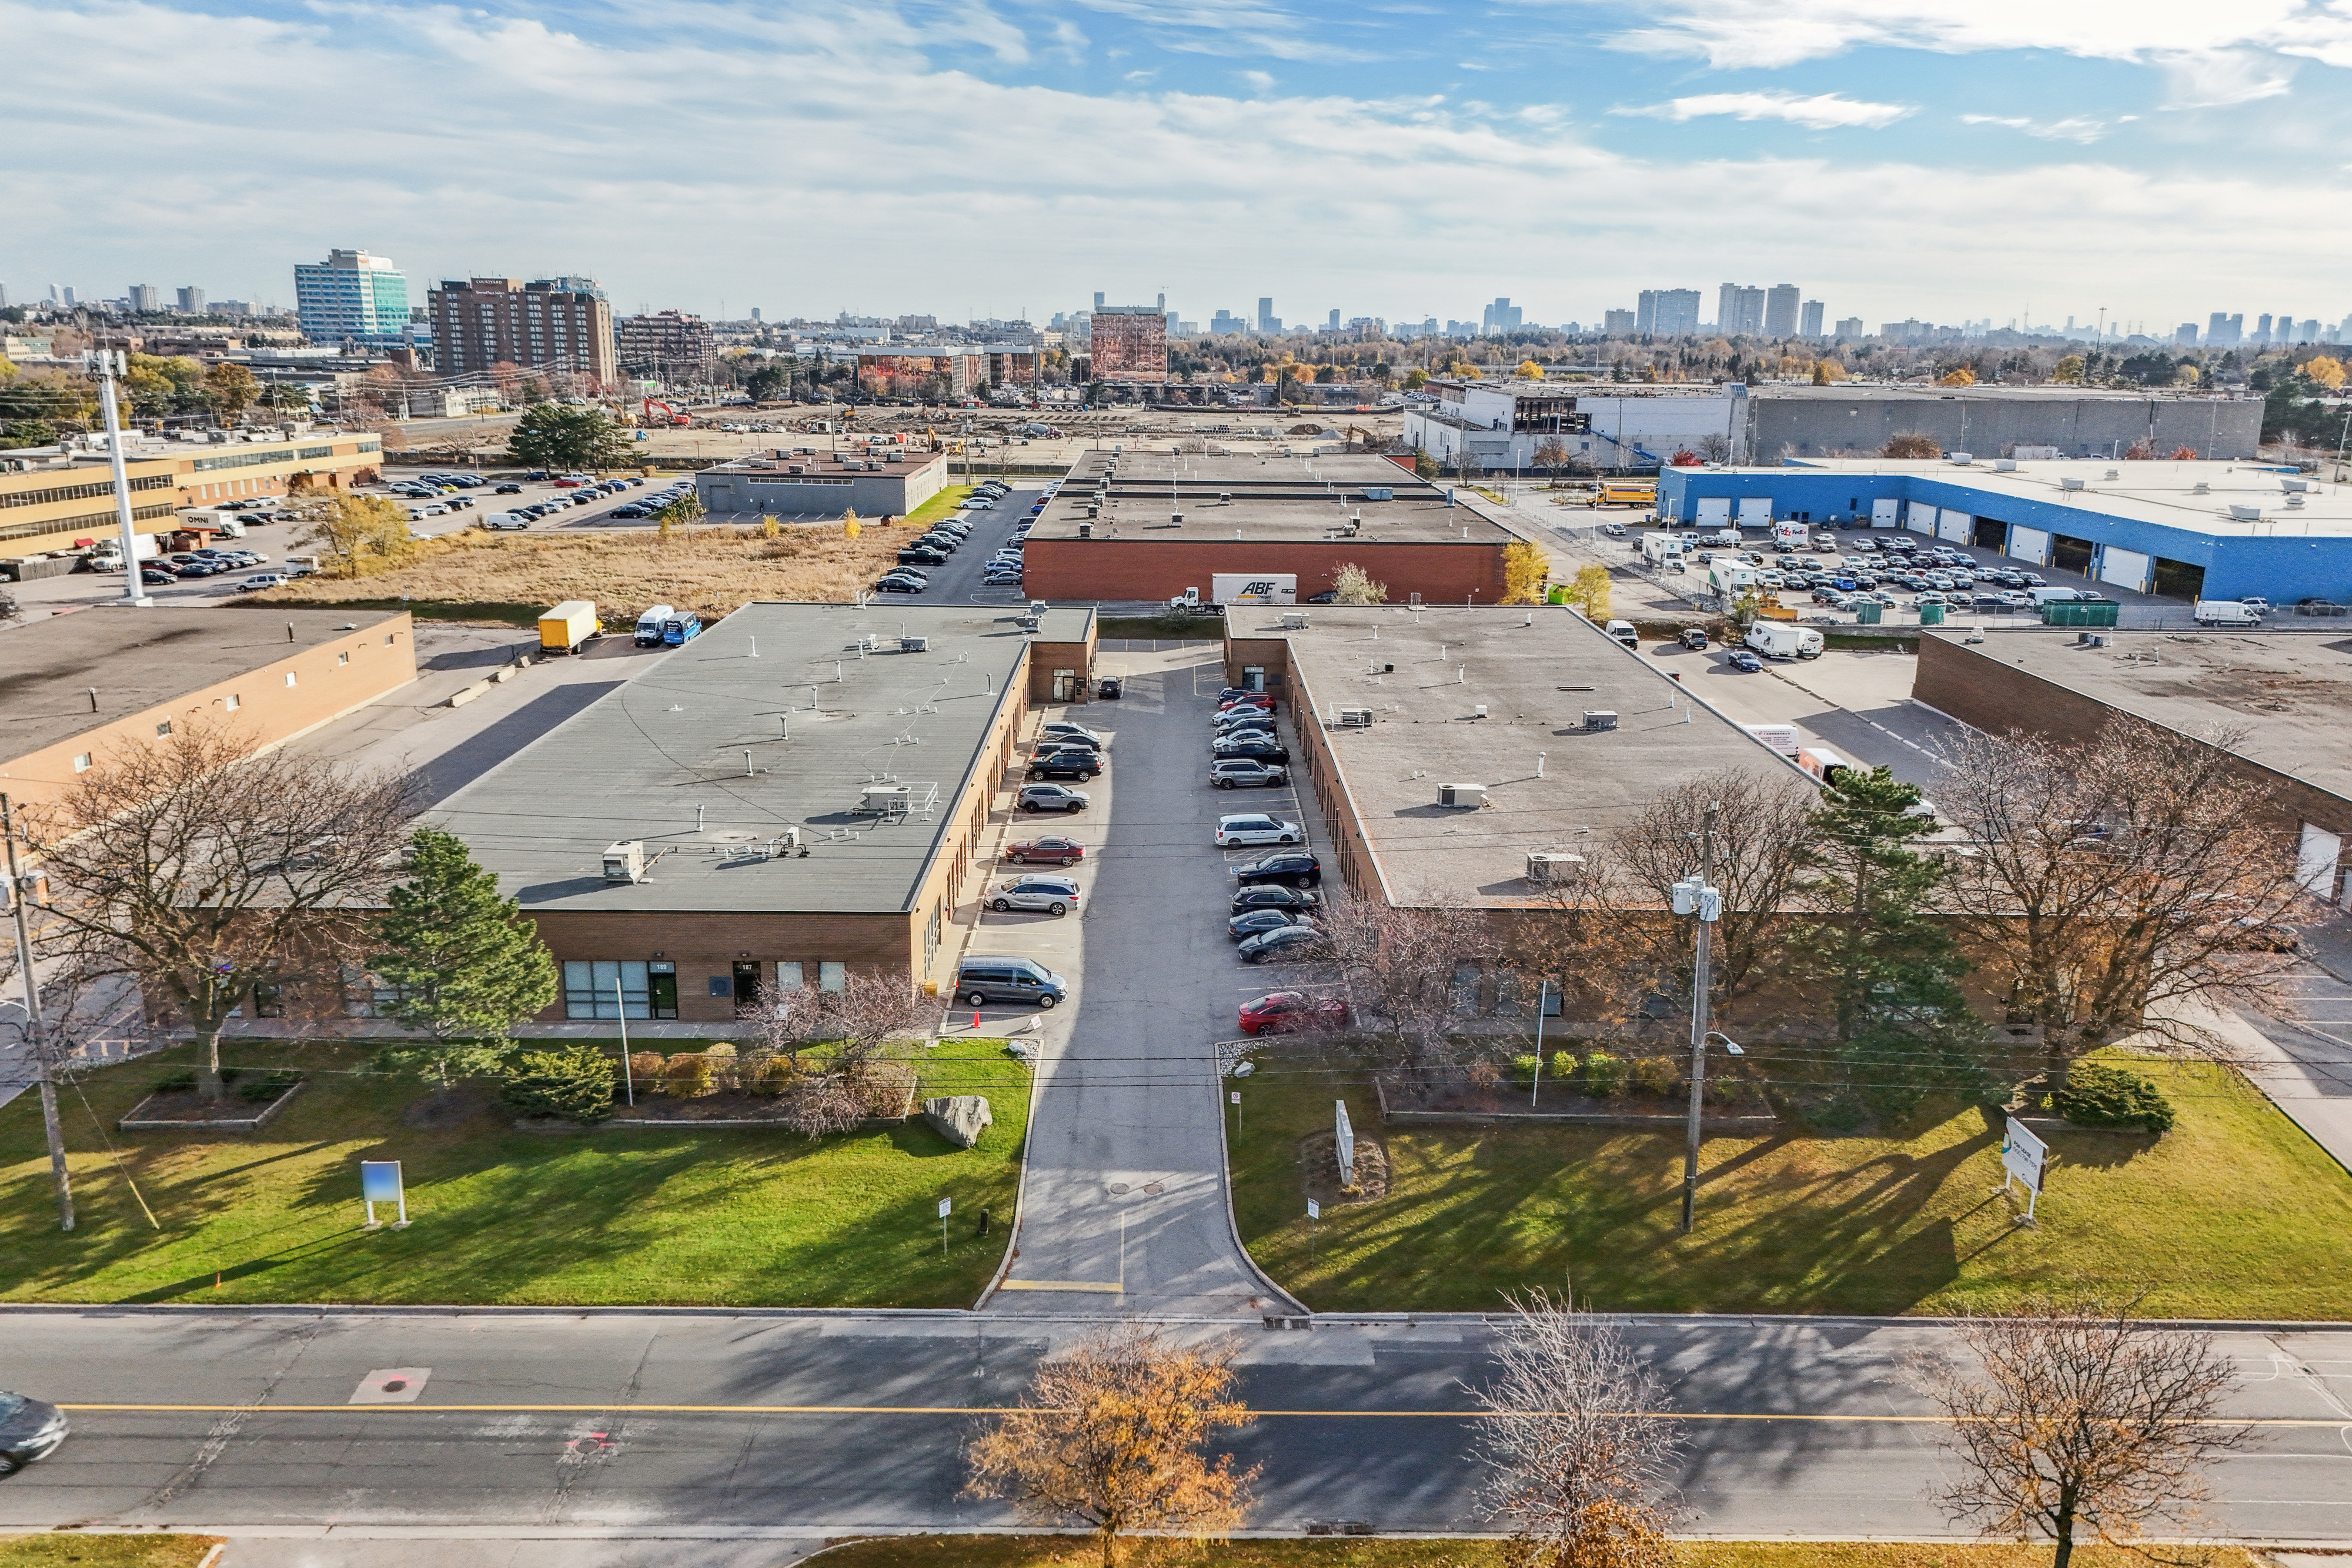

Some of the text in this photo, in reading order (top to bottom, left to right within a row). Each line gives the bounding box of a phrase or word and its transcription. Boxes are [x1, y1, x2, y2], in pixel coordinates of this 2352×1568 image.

[1779, 525, 1791, 537] FedEx
[1241, 582, 1275, 594] ABF
[2020, 1146, 2032, 1158] LEASE
